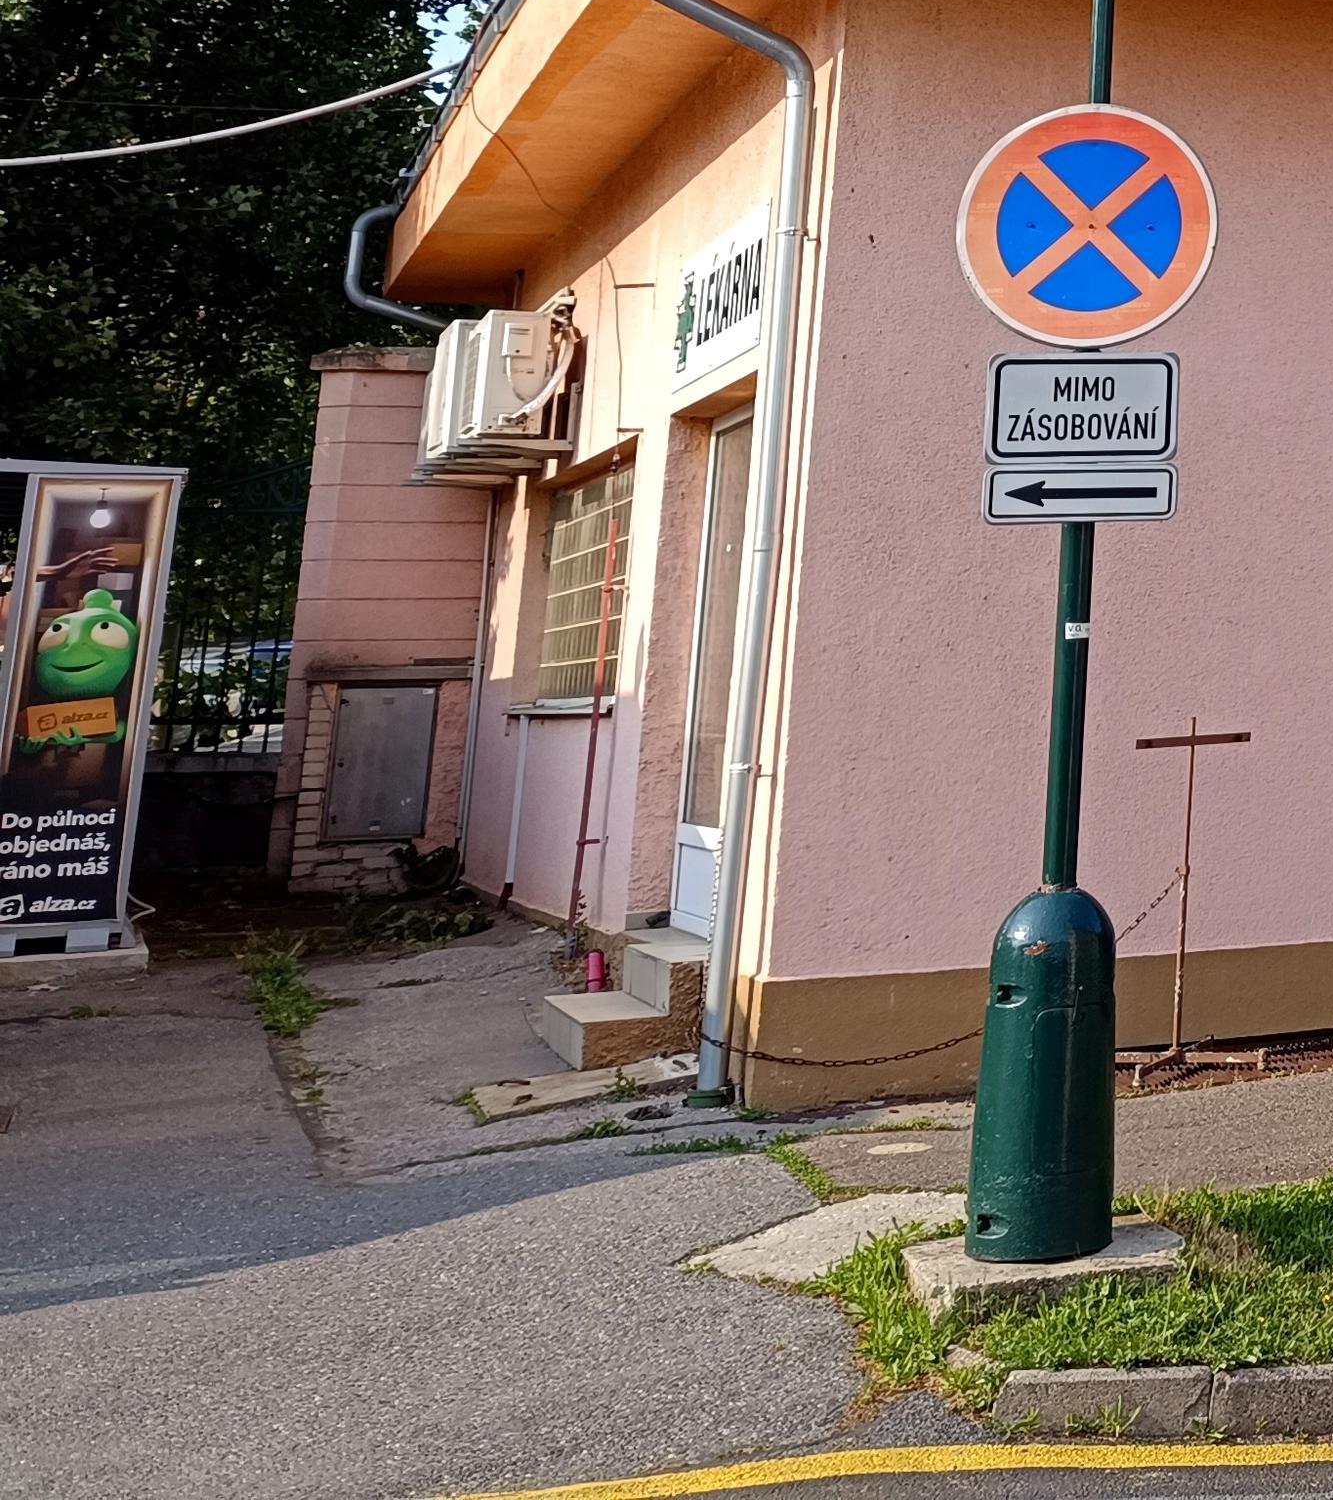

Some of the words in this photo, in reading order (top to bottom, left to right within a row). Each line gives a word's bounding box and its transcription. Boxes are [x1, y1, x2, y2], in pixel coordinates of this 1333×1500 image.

[696, 238, 763, 347] LÉKÁRNA
[1053, 376, 1115, 402] MIMO
[1007, 406, 1160, 441] ZÁSOBOVÁNÍ
[61, 712, 108, 725] alza.cz
[2, 813, 33, 829] Do
[37, 808, 117, 832] půlnoci
[0, 832, 111, 858] objednáš,
[57, 856, 111, 877] máš
[29, 896, 97, 913] alza.cz
